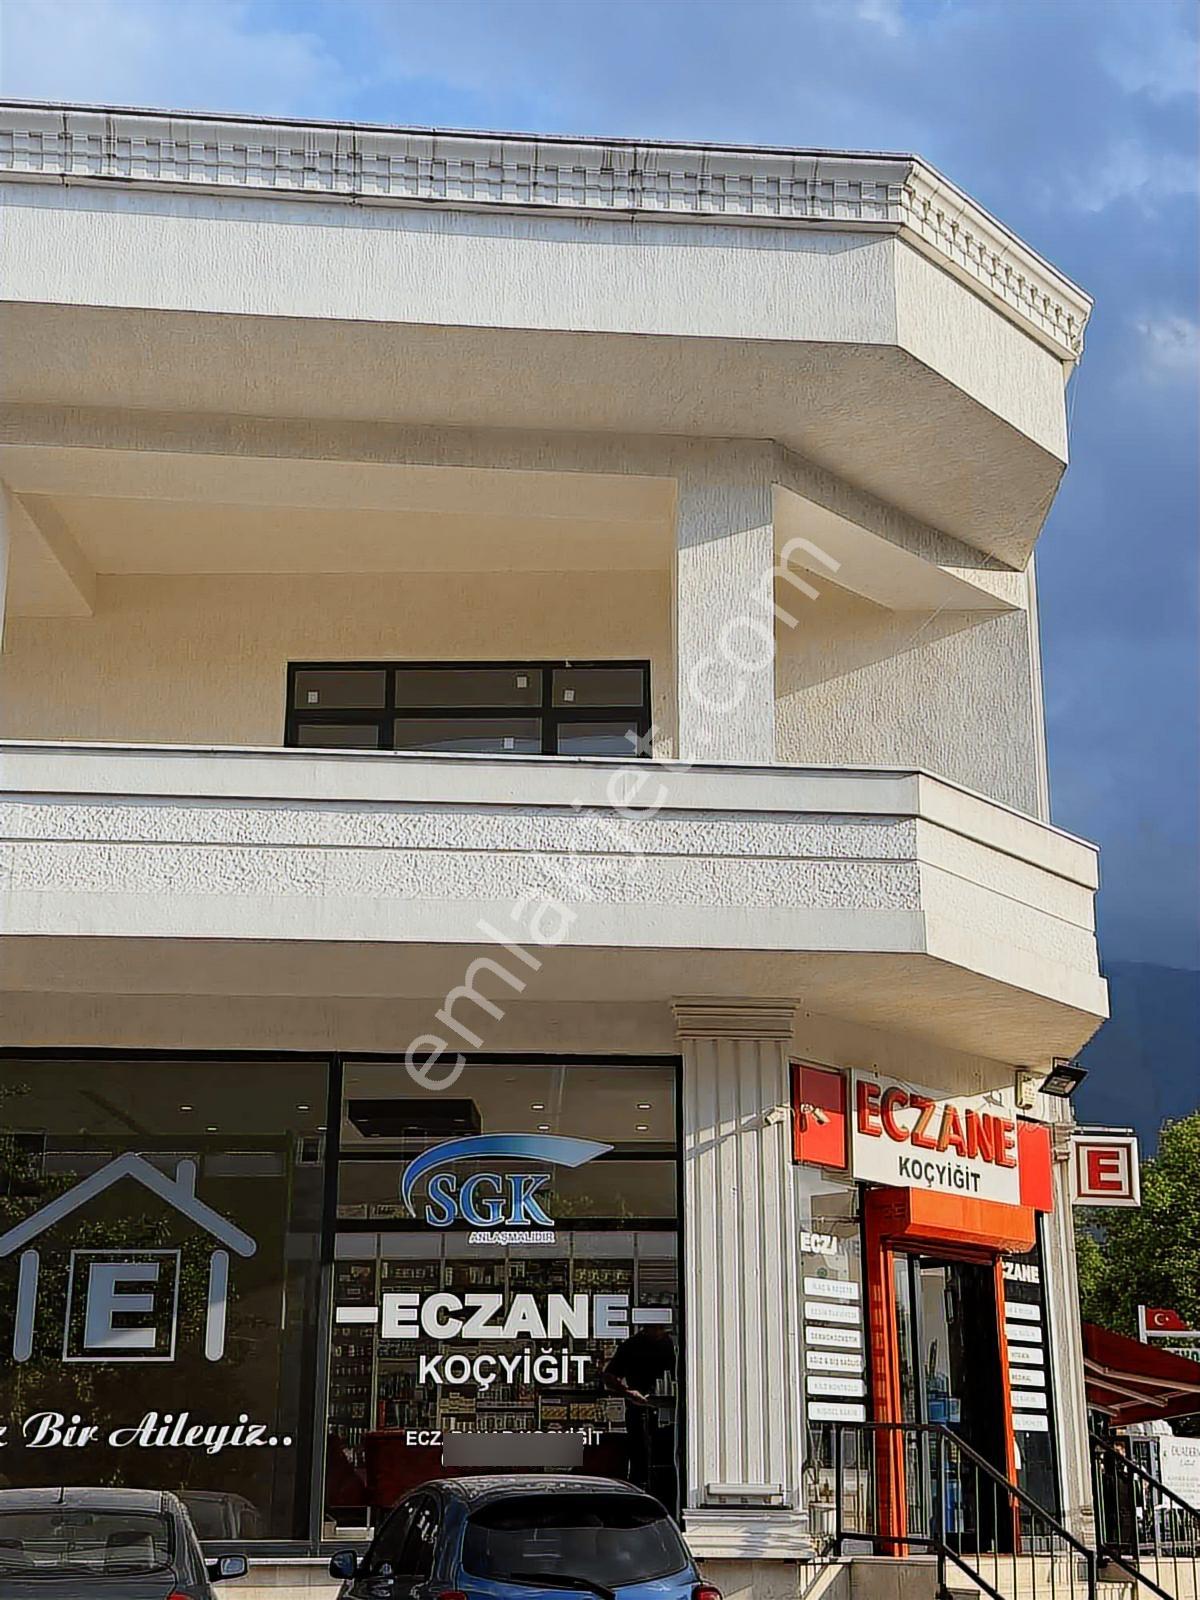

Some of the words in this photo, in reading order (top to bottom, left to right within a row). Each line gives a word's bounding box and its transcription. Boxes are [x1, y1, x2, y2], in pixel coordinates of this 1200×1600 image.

[856, 1079, 1017, 1169] ECZANE
[899, 1155, 981, 1193] KOÇYİĞİT
[1087, 1149, 1123, 1191] E
[425, 1173, 555, 1227] SGK
[84, 1263, 160, 1348] E
[381, 1293, 630, 1339] ECZANE
[418, 1347, 592, 1391] KOÇYİĞİT
[23, 1411, 99, 1448] Bir
[108, 1411, 292, 1454] Aileyiz..
